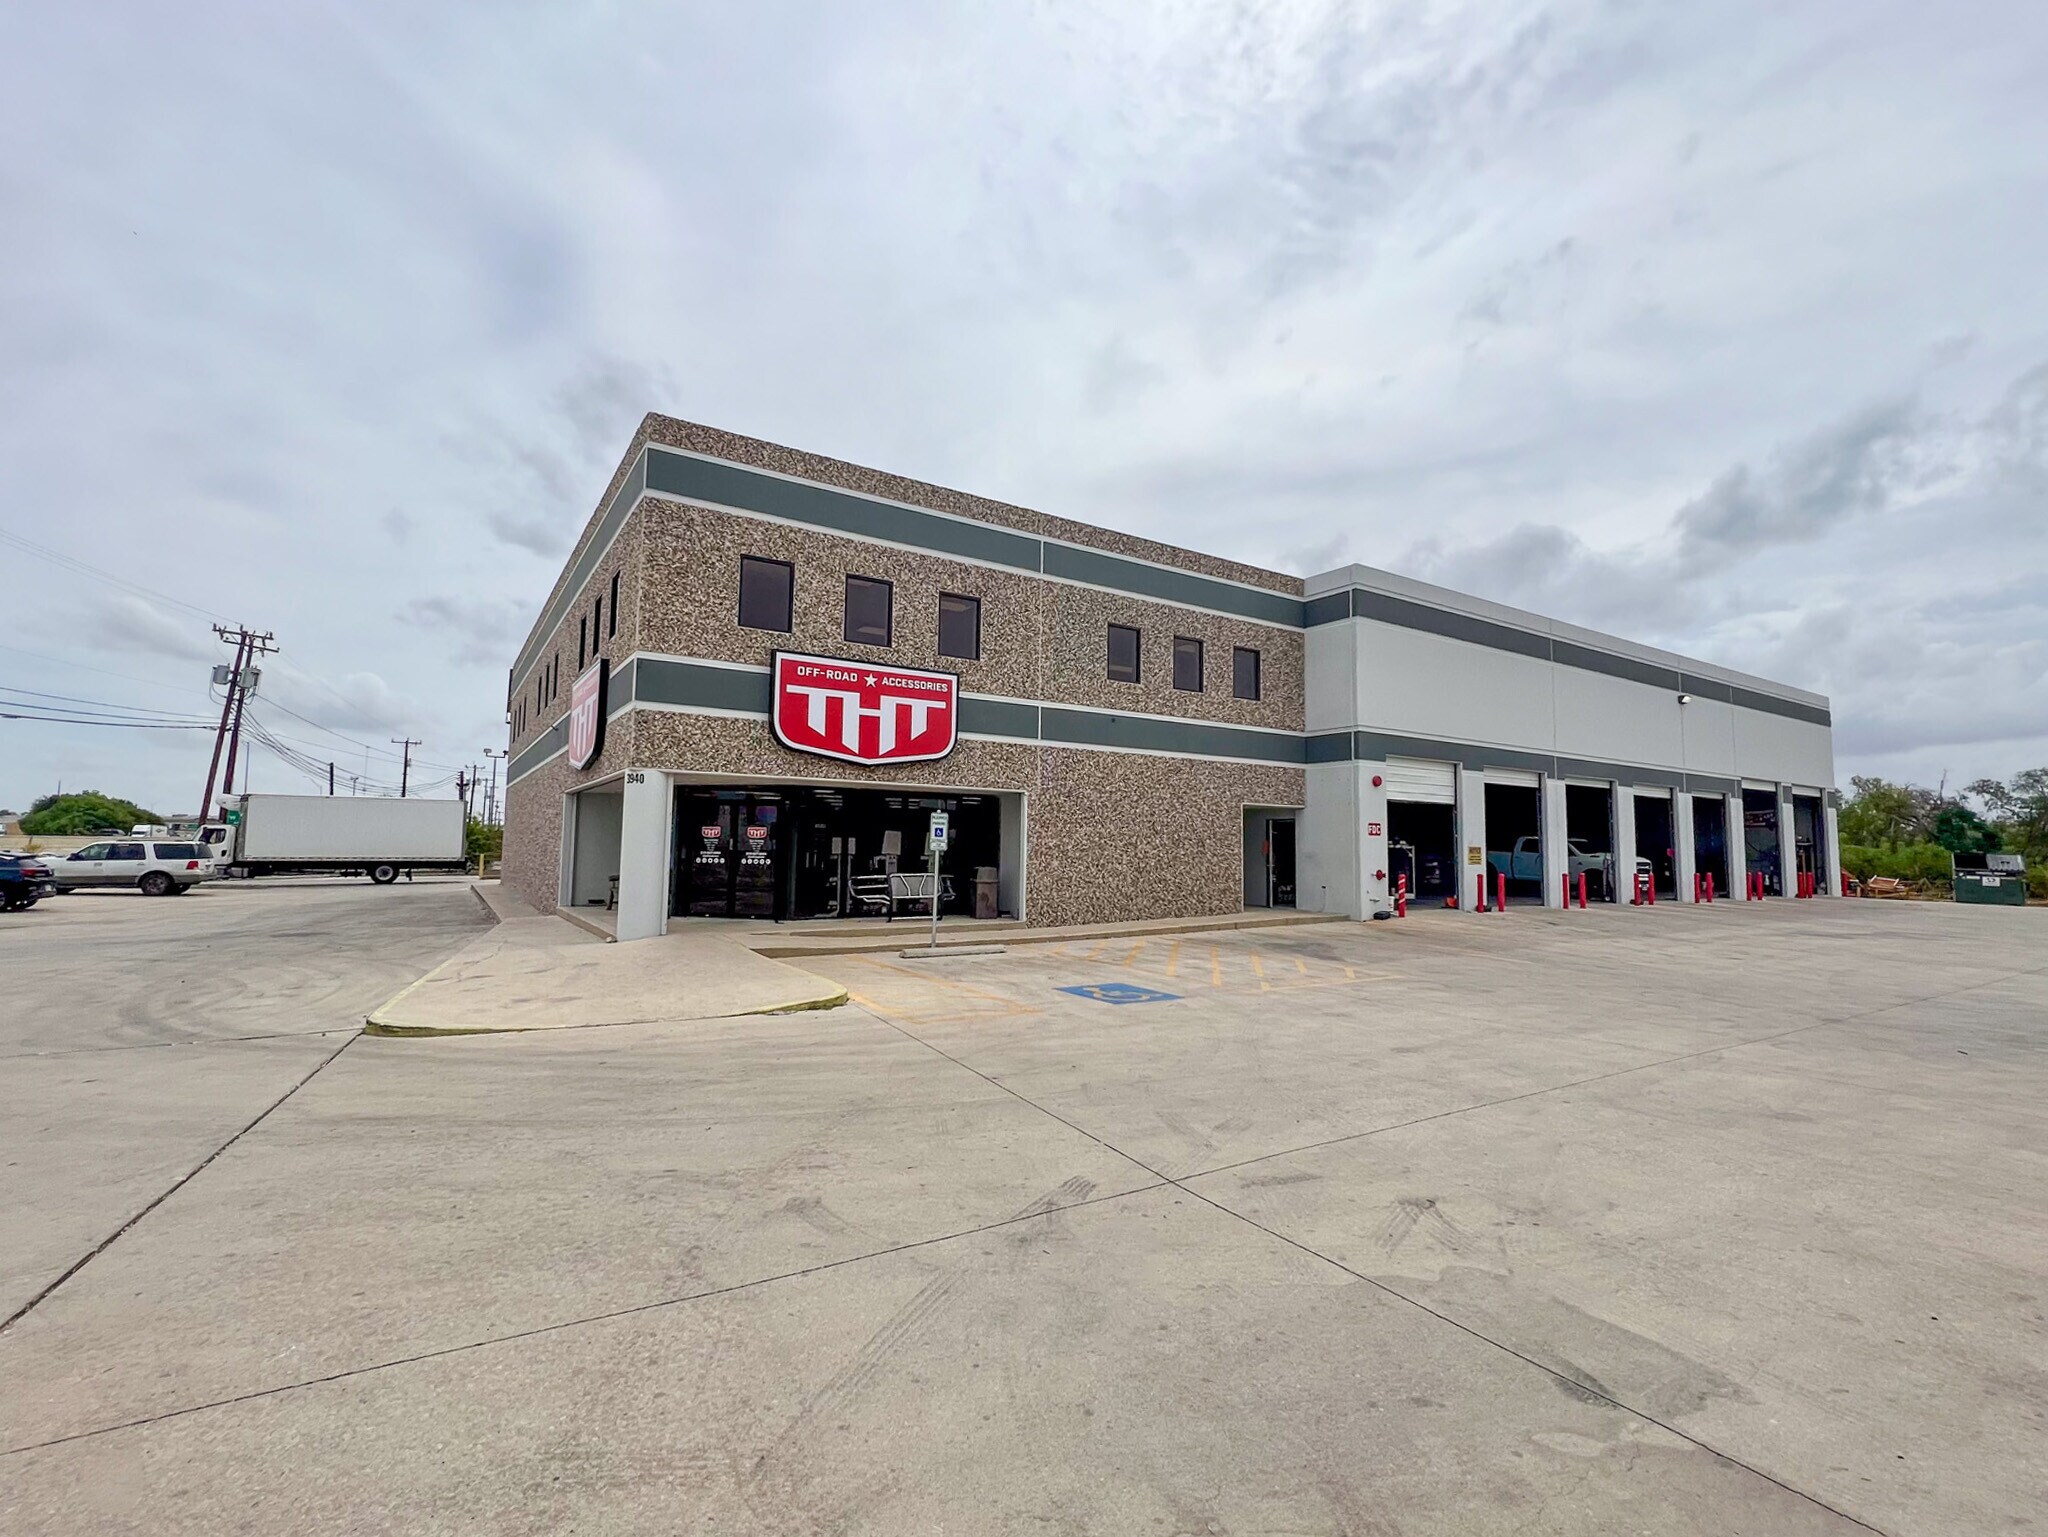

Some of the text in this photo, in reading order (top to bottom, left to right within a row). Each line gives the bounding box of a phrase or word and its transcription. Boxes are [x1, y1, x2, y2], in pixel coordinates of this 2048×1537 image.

[797, 666, 949, 693] OFF-ROAD ACCESSORIES
[571, 692, 598, 760] THT
[786, 684, 947, 756] THT
[626, 773, 645, 784] 3940
